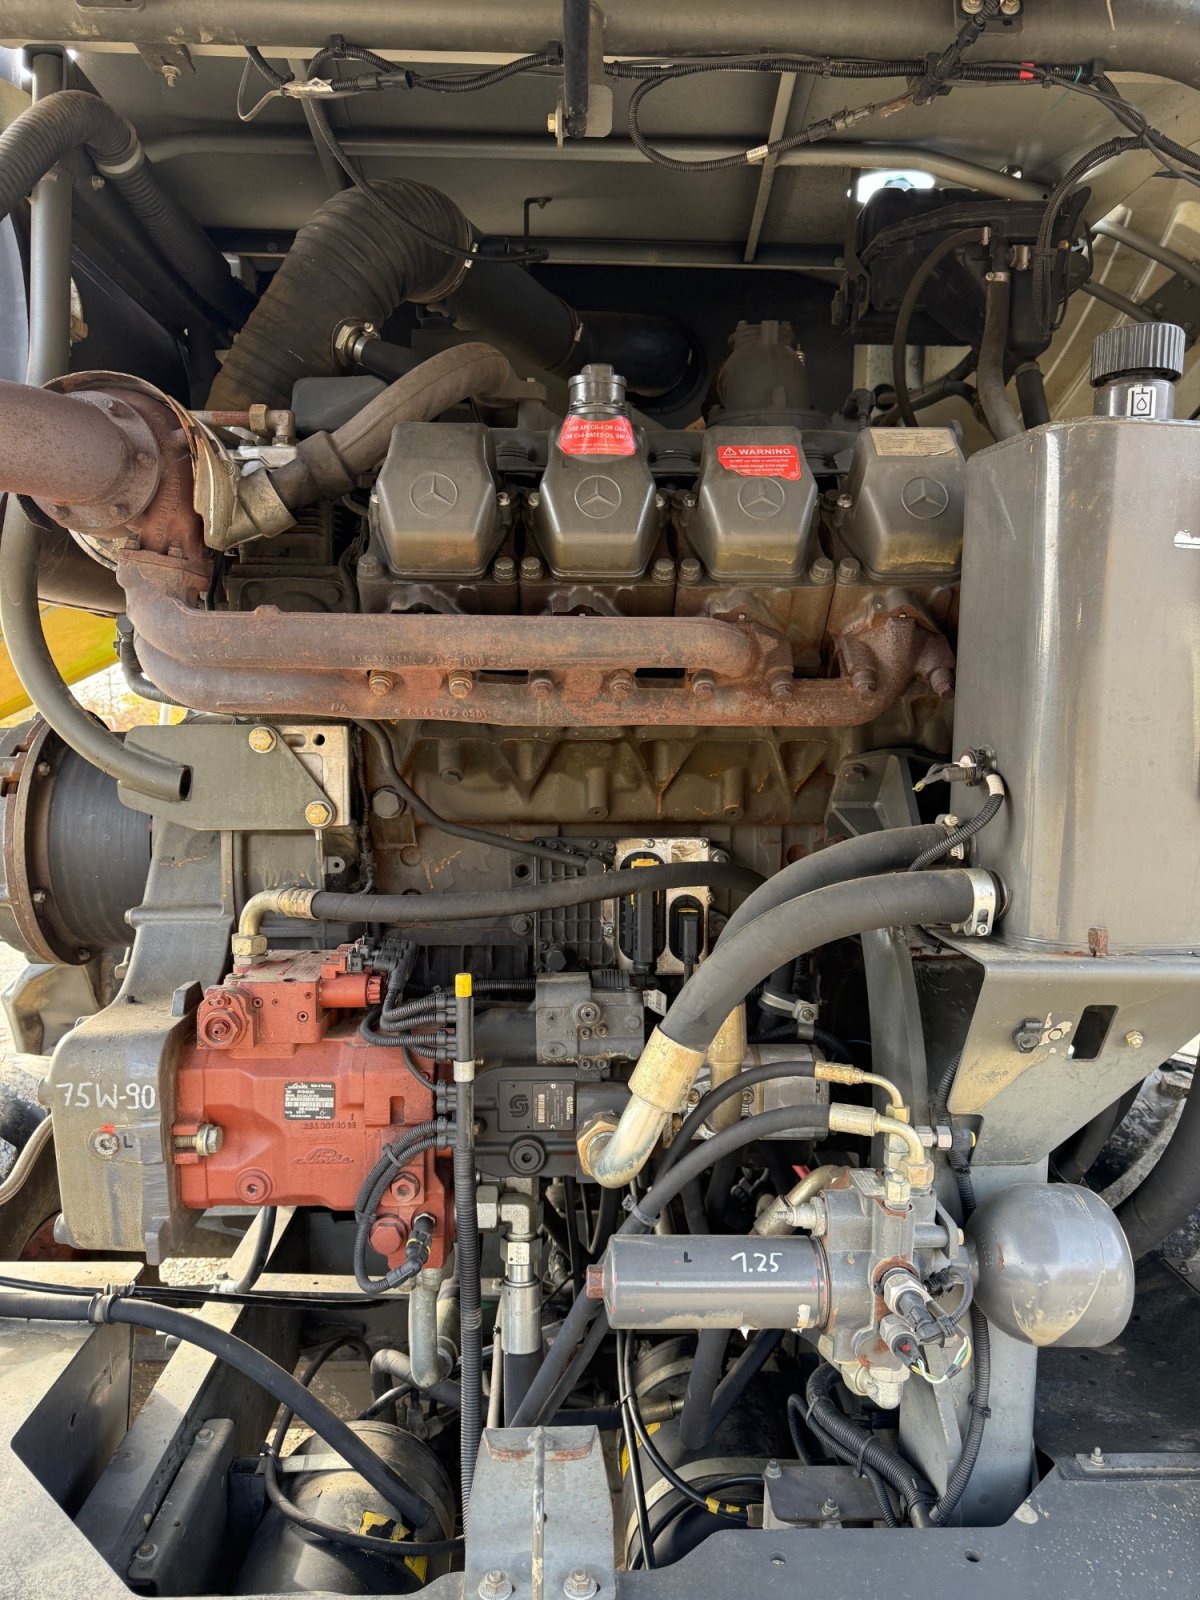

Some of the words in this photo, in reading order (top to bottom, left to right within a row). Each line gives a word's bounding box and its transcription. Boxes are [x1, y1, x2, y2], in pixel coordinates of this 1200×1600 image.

[738, 448, 791, 456] WARNING
[56, 1082, 155, 1109] 75W-90
[730, 1251, 783, 1273] 1.25
